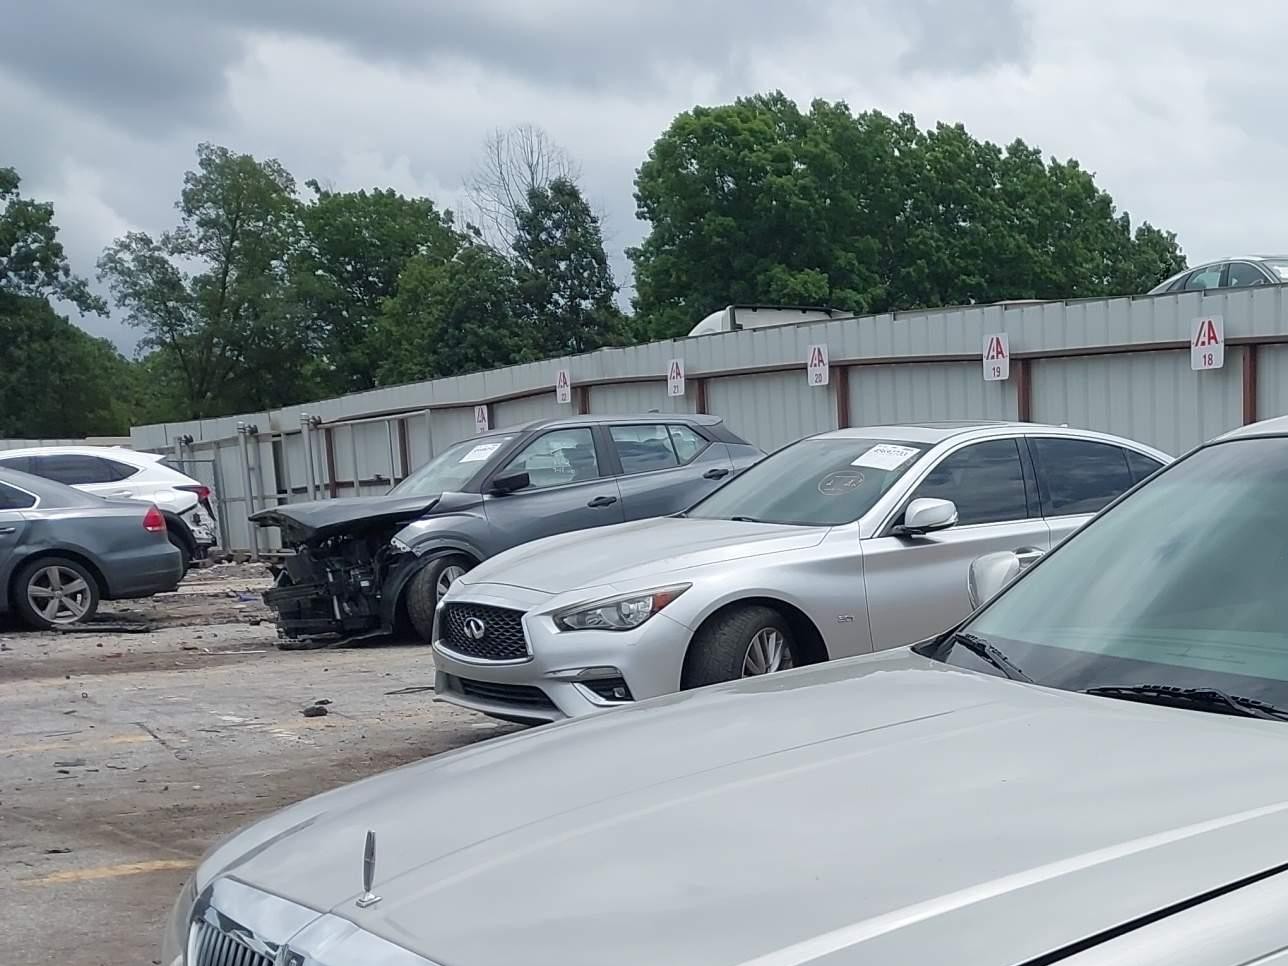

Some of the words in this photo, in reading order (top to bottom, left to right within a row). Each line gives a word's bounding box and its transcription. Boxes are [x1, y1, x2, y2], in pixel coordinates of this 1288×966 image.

[1203, 353, 1213, 366] 18
[992, 366, 1001, 377] 19
[815, 373, 822, 384] 20
